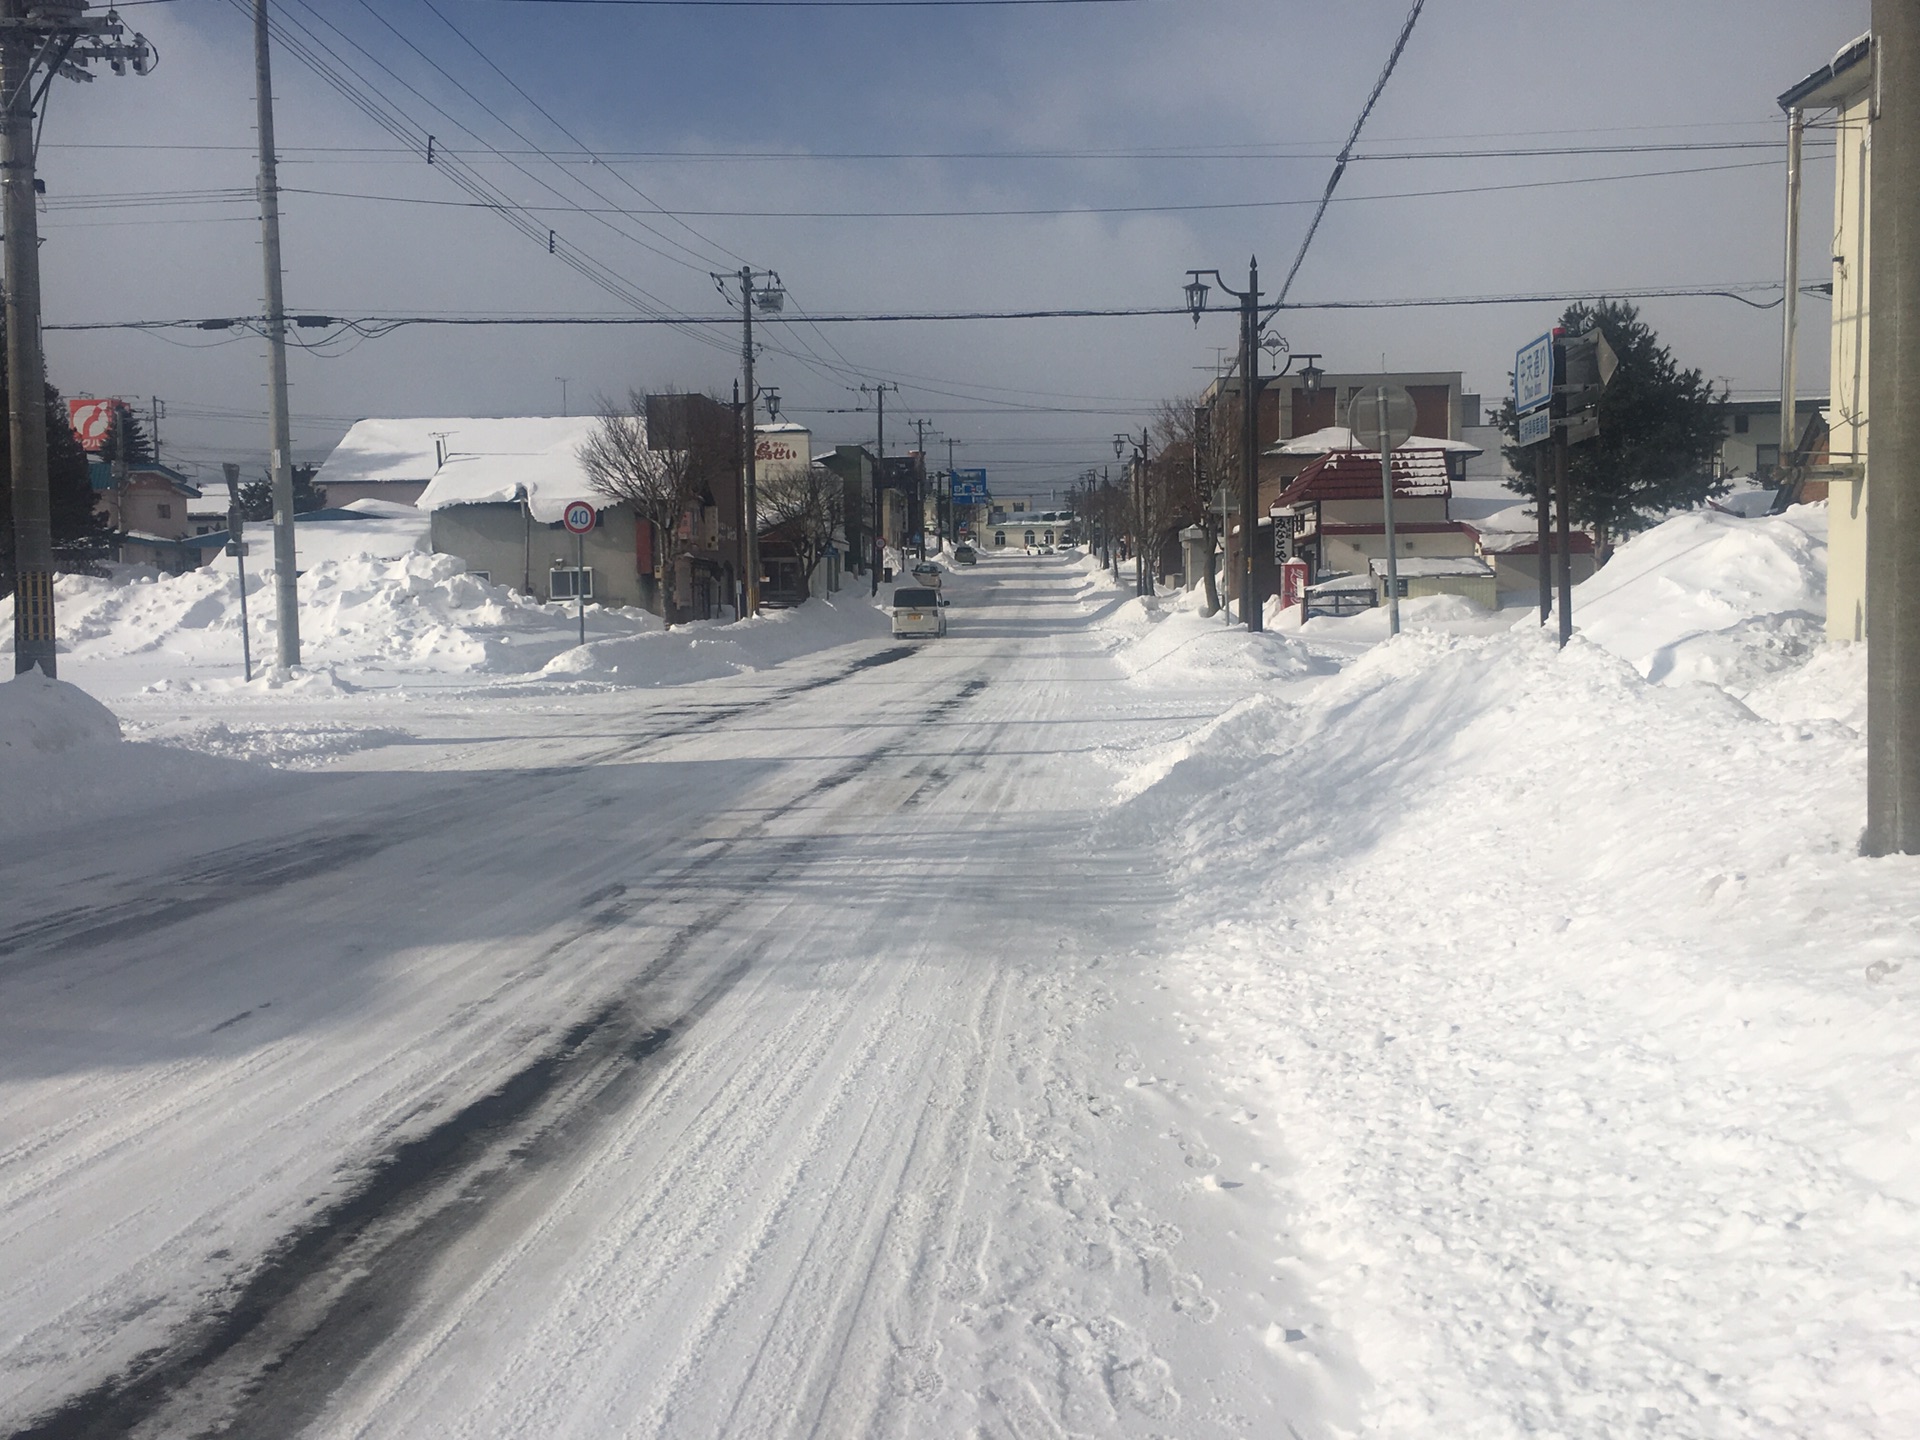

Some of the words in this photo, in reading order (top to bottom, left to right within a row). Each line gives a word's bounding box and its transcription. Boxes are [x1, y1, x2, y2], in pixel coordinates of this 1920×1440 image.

[1520, 346, 1546, 385] 中央通り
[570, 510, 589, 525] 40
[1275, 518, 1287, 563] みなとや
